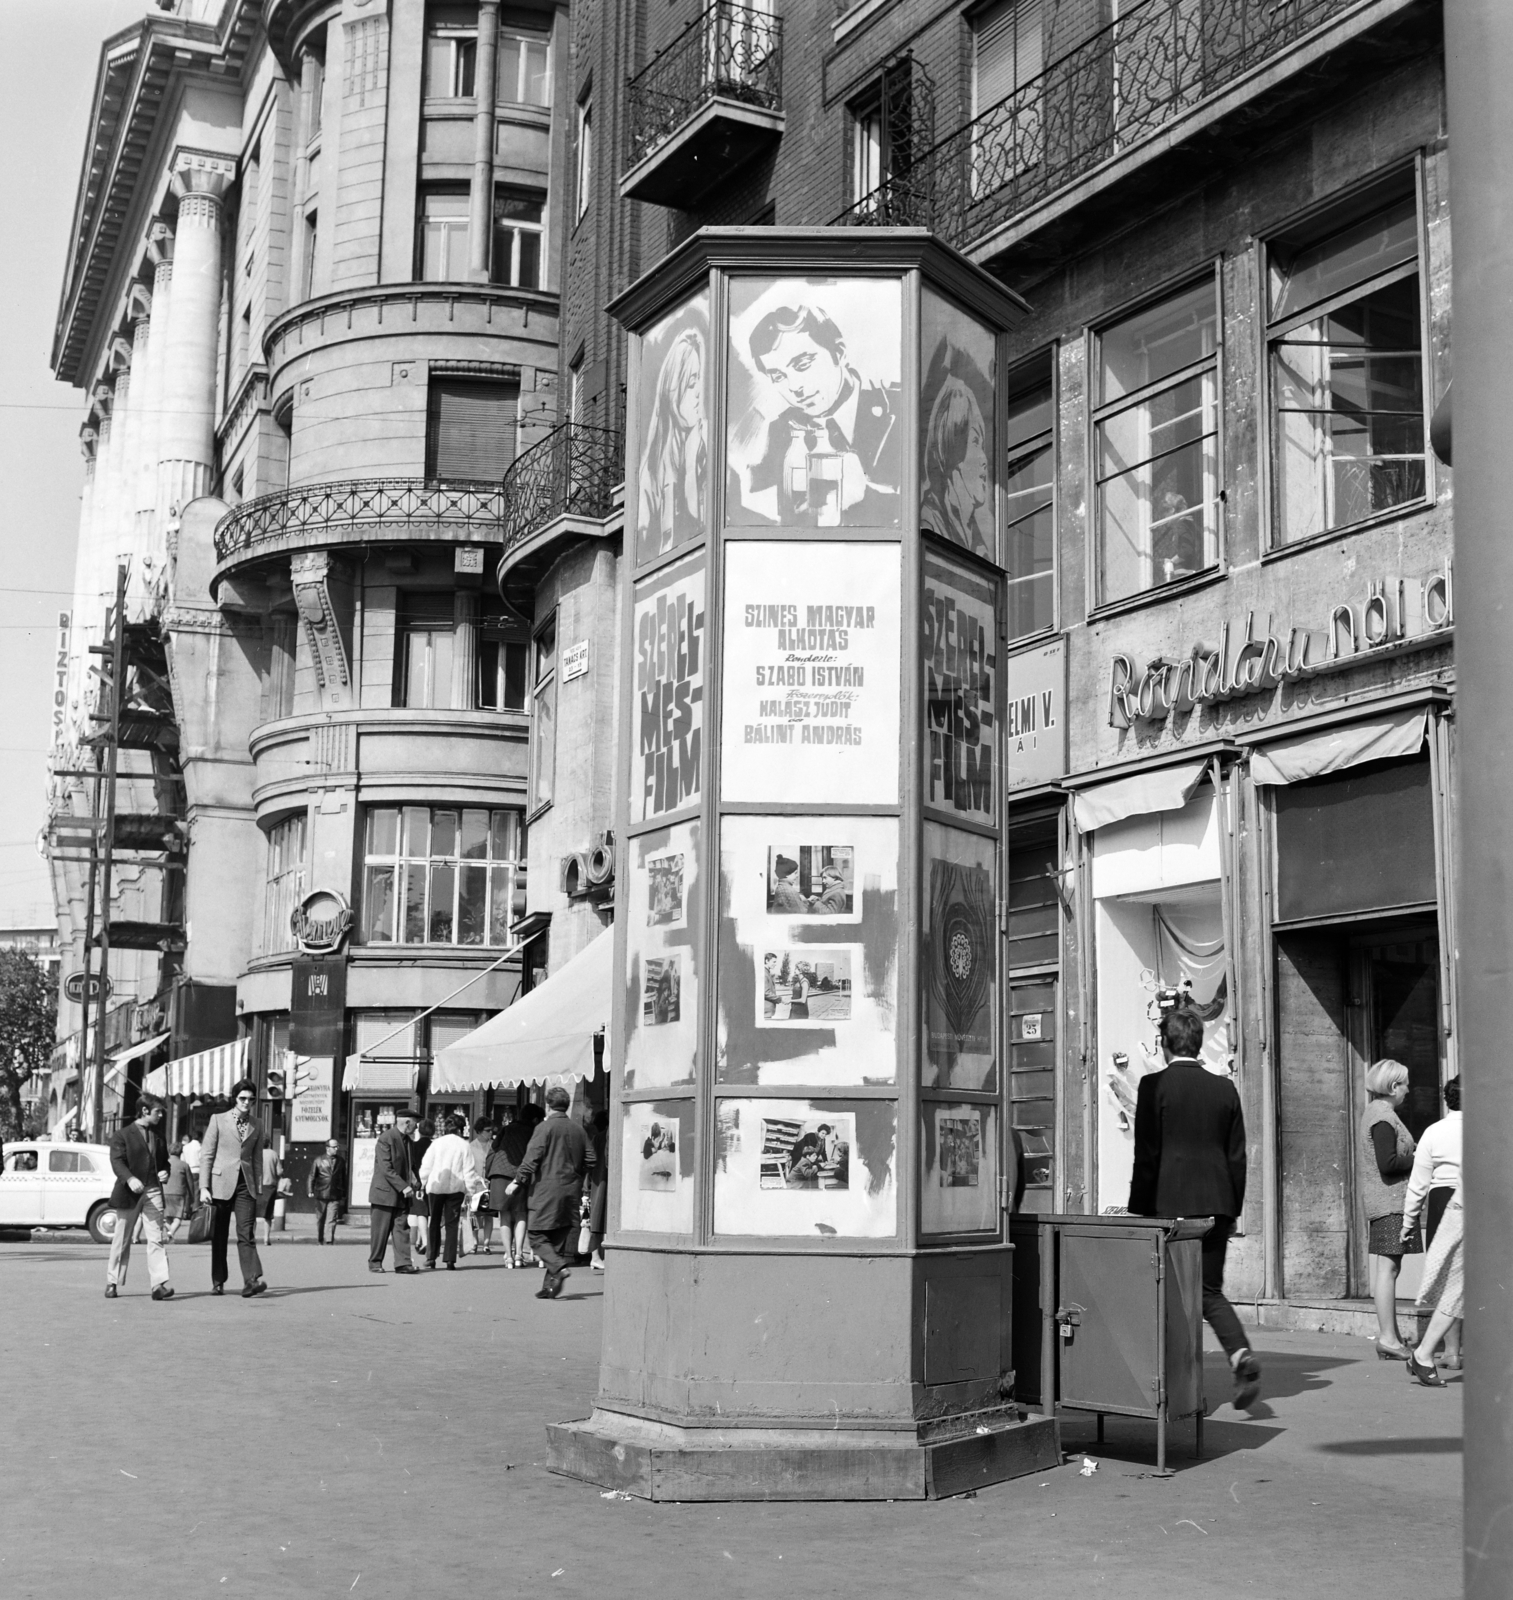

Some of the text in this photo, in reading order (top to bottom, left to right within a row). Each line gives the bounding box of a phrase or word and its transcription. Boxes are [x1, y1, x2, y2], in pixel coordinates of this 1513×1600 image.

[744, 604, 876, 629] SZINES MAGYAR
[777, 628, 849, 651] ALKOTÁS
[756, 663, 864, 687] SZABÓ ISTVÁN
[639, 680, 703, 757] MES-
[759, 698, 852, 719] HALÁSZ JUDIT
[744, 723, 862, 746] BÁLINT ANDRÁS
[642, 727, 700, 820] FILM
[929, 730, 992, 815] FILM
